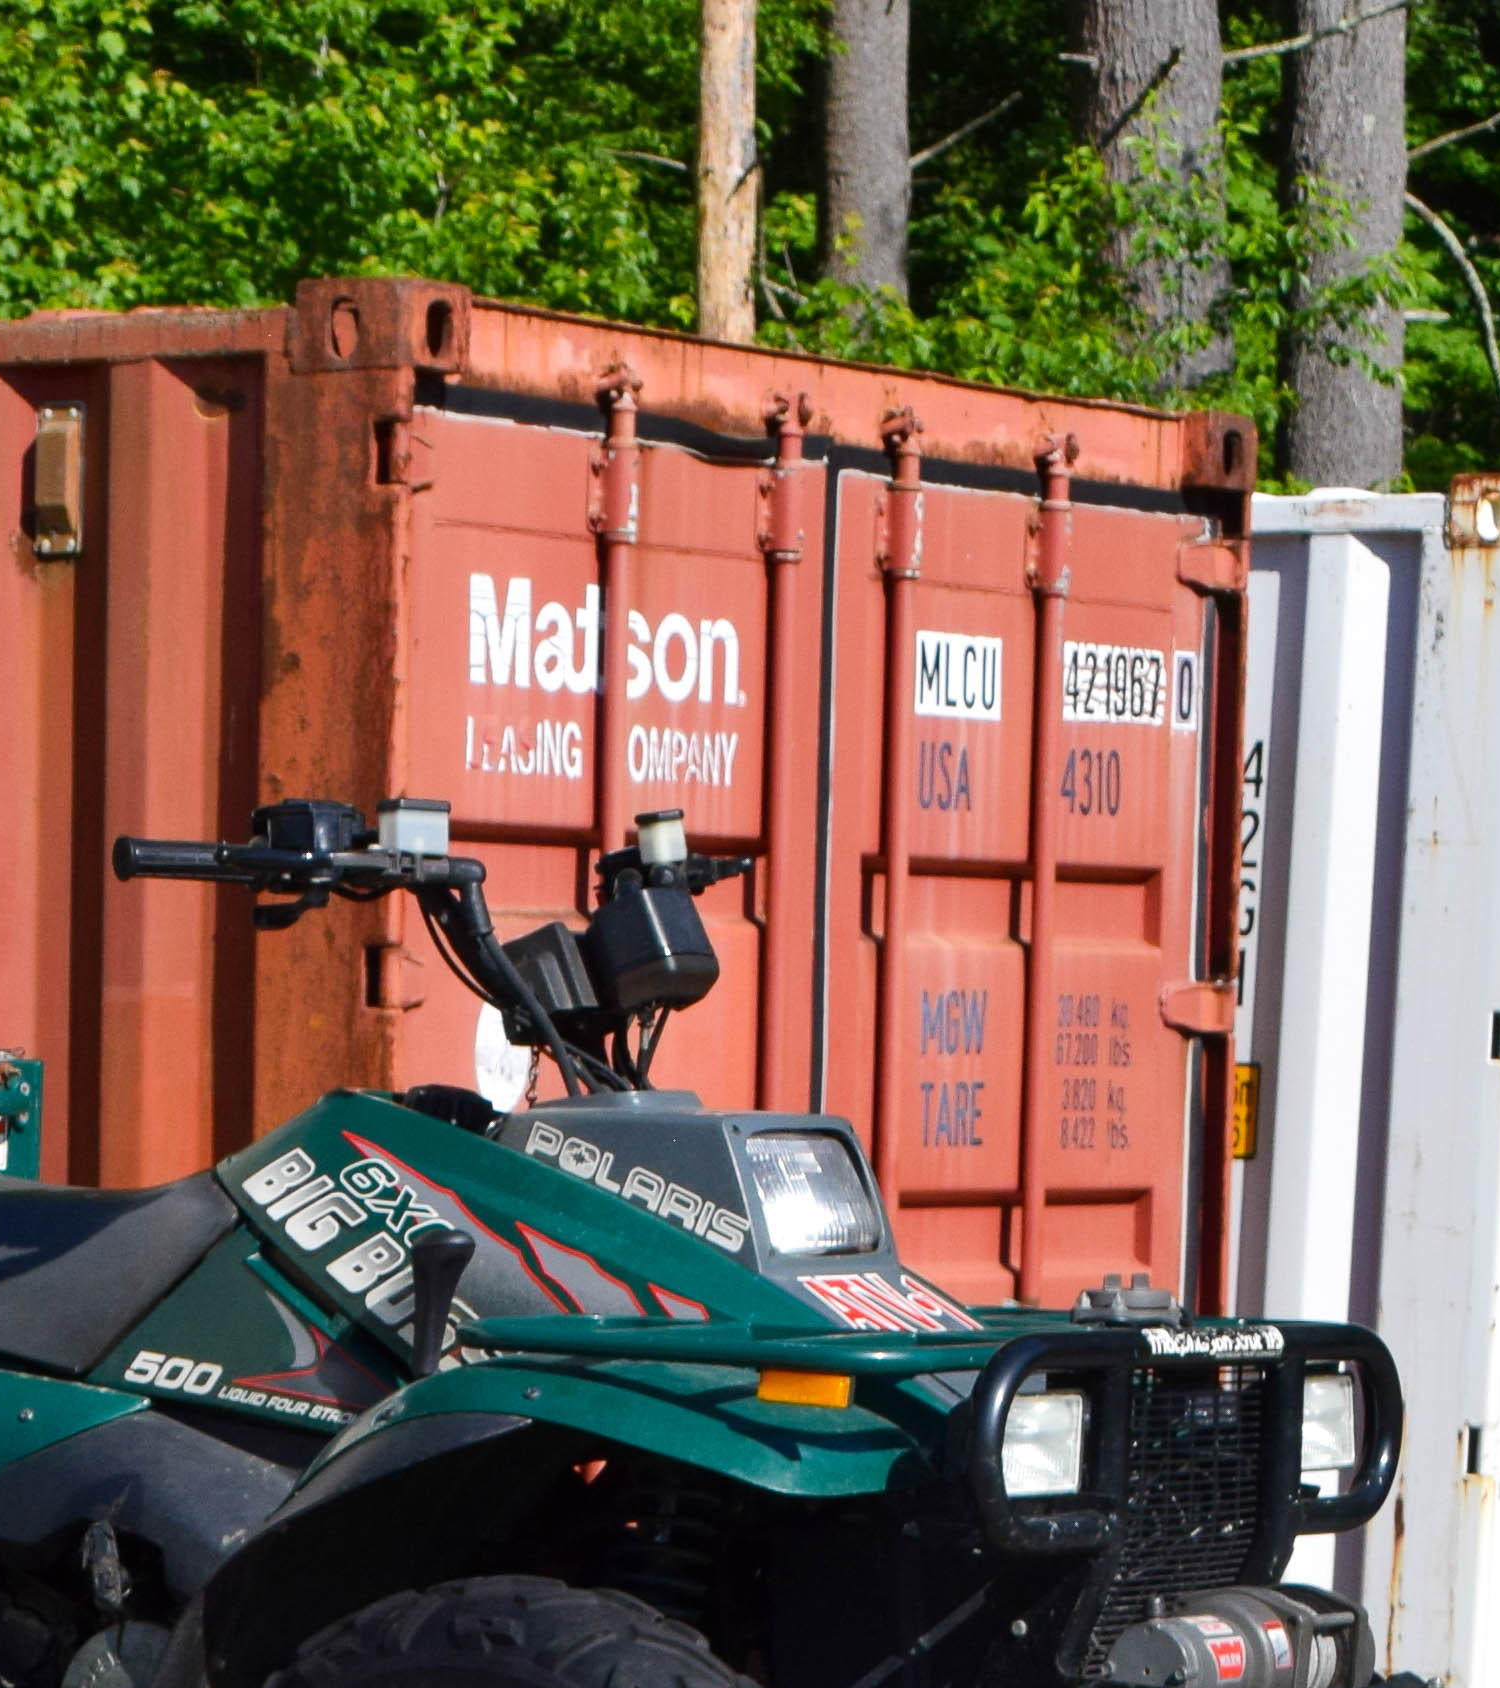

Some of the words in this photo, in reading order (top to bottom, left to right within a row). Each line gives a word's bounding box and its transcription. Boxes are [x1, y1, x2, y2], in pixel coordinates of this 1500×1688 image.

[469, 573, 740, 705] Matson
[920, 640, 996, 710] MLCU
[1066, 650, 1163, 718] 421967
[627, 724, 739, 787] OMPANY
[918, 741, 971, 811] USA
[1060, 749, 1121, 816] 4310
[920, 989, 988, 1055] MGW
[920, 1082, 985, 1148] TARE
[241, 1146, 369, 1252] BIG
[524, 1119, 752, 1252] POLARIS
[123, 1350, 224, 1396] 500
[217, 1385, 268, 1407] LIQUID
[265, 1396, 310, 1416] FOUR
[308, 1405, 355, 1425] STRO
